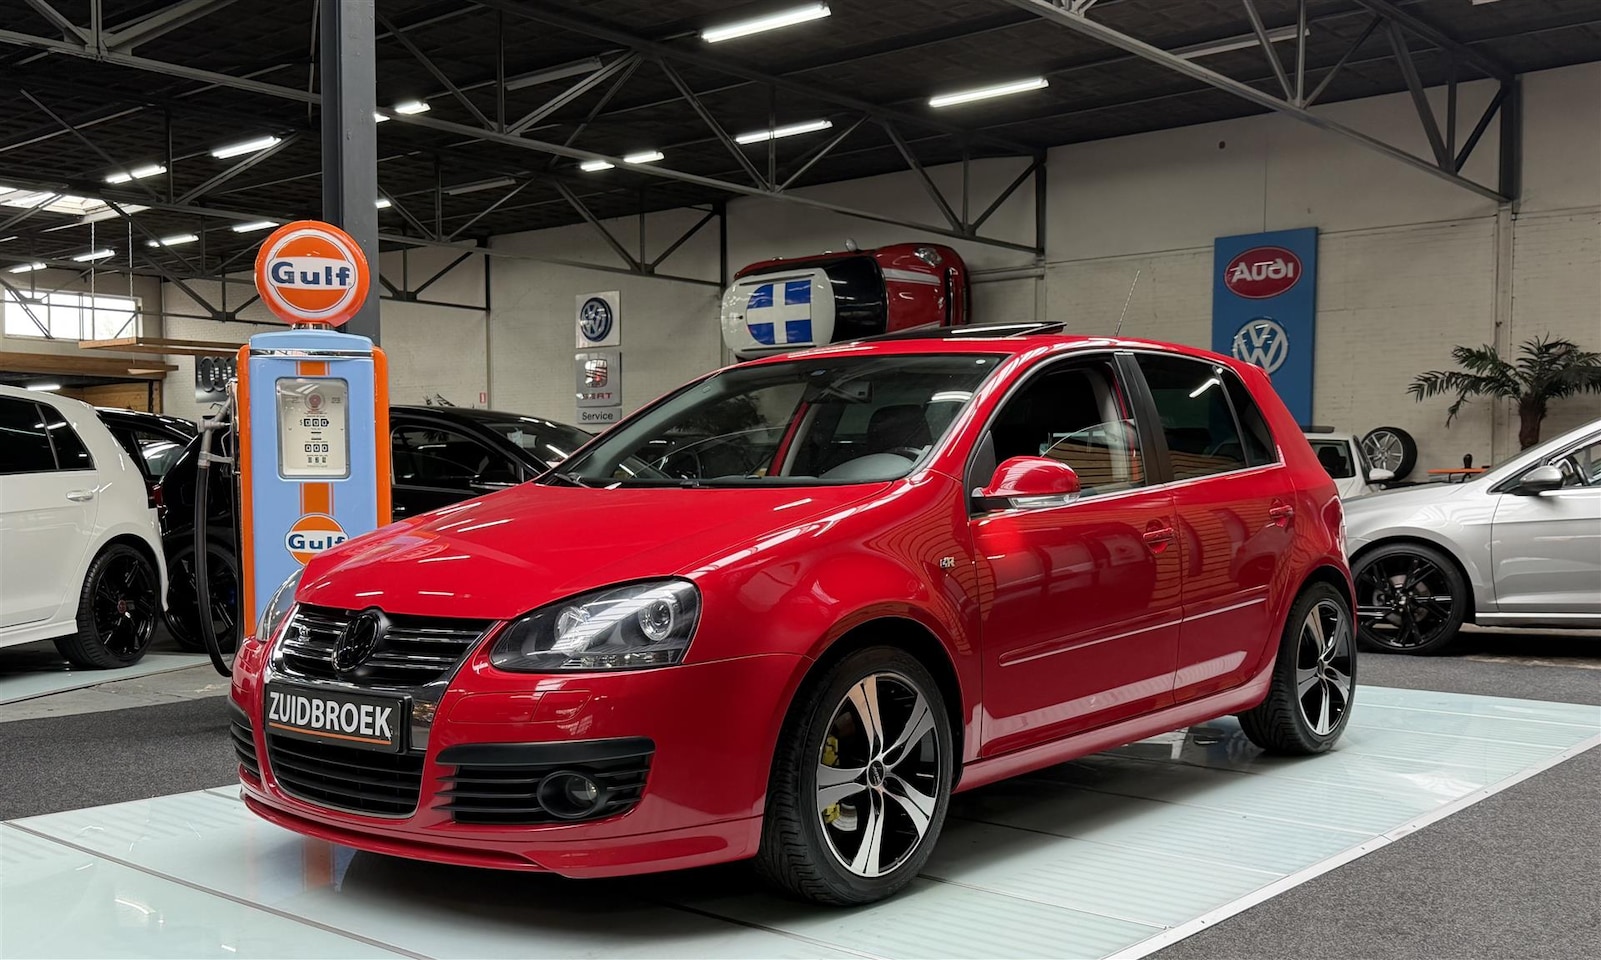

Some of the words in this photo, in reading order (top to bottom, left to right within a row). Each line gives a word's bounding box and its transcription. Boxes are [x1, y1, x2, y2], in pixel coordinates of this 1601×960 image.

[271, 261, 350, 286] Gulf
[582, 411, 613, 421] Service
[269, 692, 392, 739] ZUIDBROEK
